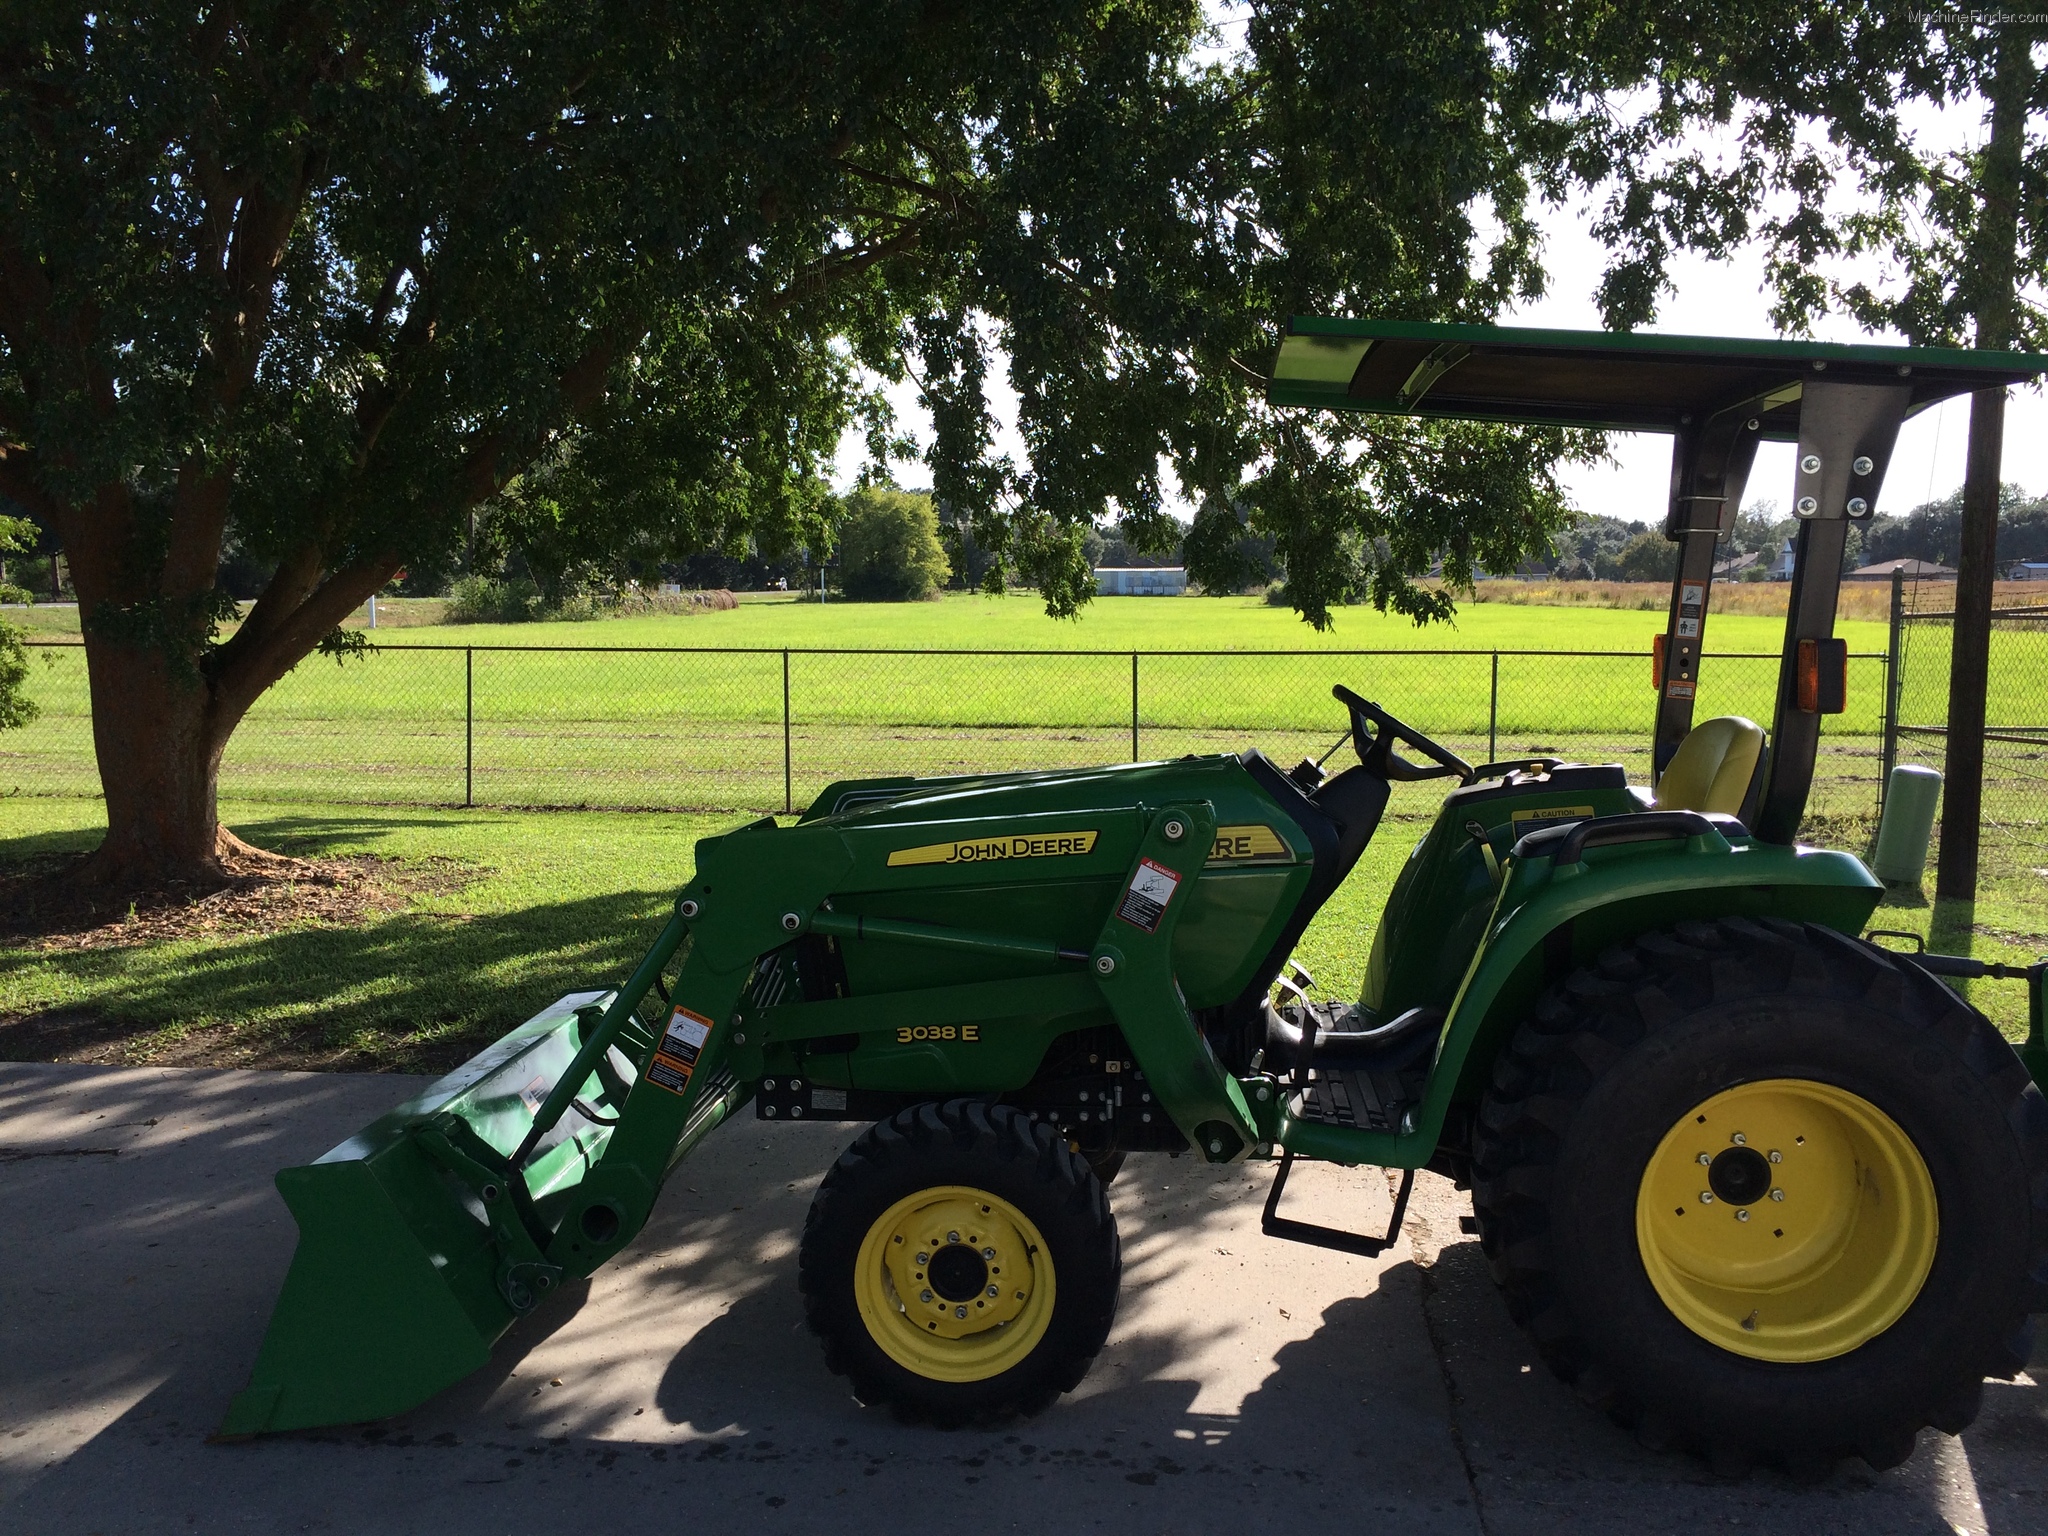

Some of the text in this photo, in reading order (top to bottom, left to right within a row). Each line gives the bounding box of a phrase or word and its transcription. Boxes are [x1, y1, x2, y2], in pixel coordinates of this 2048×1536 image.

[1541, 810, 1575, 818] CAUTION
[946, 837, 1086, 861] JOHN DEERE
[1153, 865, 1176, 878] DANGER
[685, 1012, 708, 1024] WARNING
[897, 1025, 979, 1043] 3038 E
